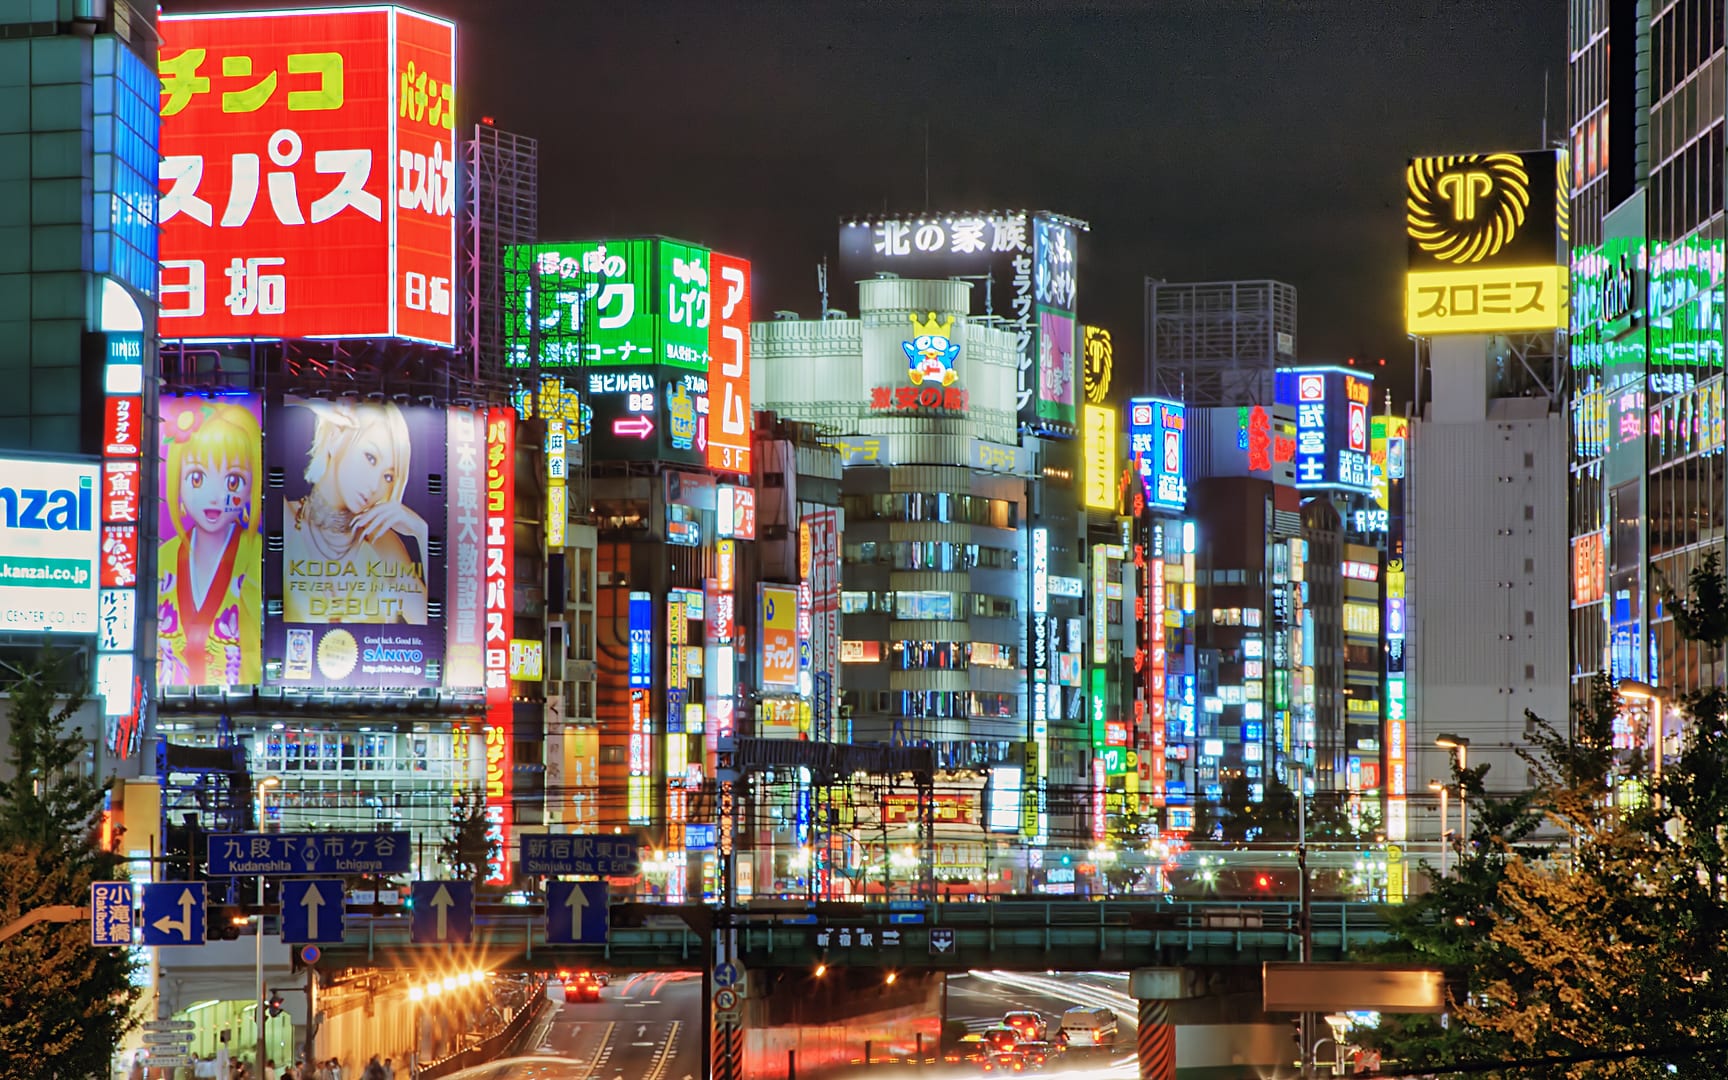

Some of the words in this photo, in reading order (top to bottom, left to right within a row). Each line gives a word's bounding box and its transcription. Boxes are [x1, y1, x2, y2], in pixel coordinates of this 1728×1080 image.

[400, 60, 456, 129] パチンコ
[399, 140, 456, 217] エスパス
[537, 245, 627, 279] ほのぼの
[669, 283, 710, 328] レイク
[1416, 281, 1545, 319] プロミス
[721, 266, 745, 436] アコム
[1011, 253, 1033, 412] セラヴィグループ
[589, 373, 654, 393] 当ビル向い
[115, 399, 130, 443] カラオケ
[629, 394, 654, 411] B2
[722, 449, 744, 469] 3F
[1299, 403, 1324, 481] 武富士
[487, 421, 506, 512] パチンコ
[1339, 449, 1375, 486] 武富士
[108, 471, 136, 521] 魚民
[289, 559, 358, 577] KODA
[365, 560, 422, 579] KUMI
[338, 581, 365, 592] LIVE
[486, 516, 506, 642] エスパス
[103, 591, 119, 649] ルノアール
[309, 597, 403, 616] DEBUT!
[363, 644, 423, 662] SANKYO
[487, 726, 505, 797] パチンコ
[224, 838, 297, 858] 九段下
[229, 860, 291, 872] Kudanshita
[336, 859, 382, 872] Ichigaya
[527, 838, 631, 859] 新宿駅東口
[528, 860, 573, 873] Shinjuku
[108, 886, 131, 942] 小滝橋
